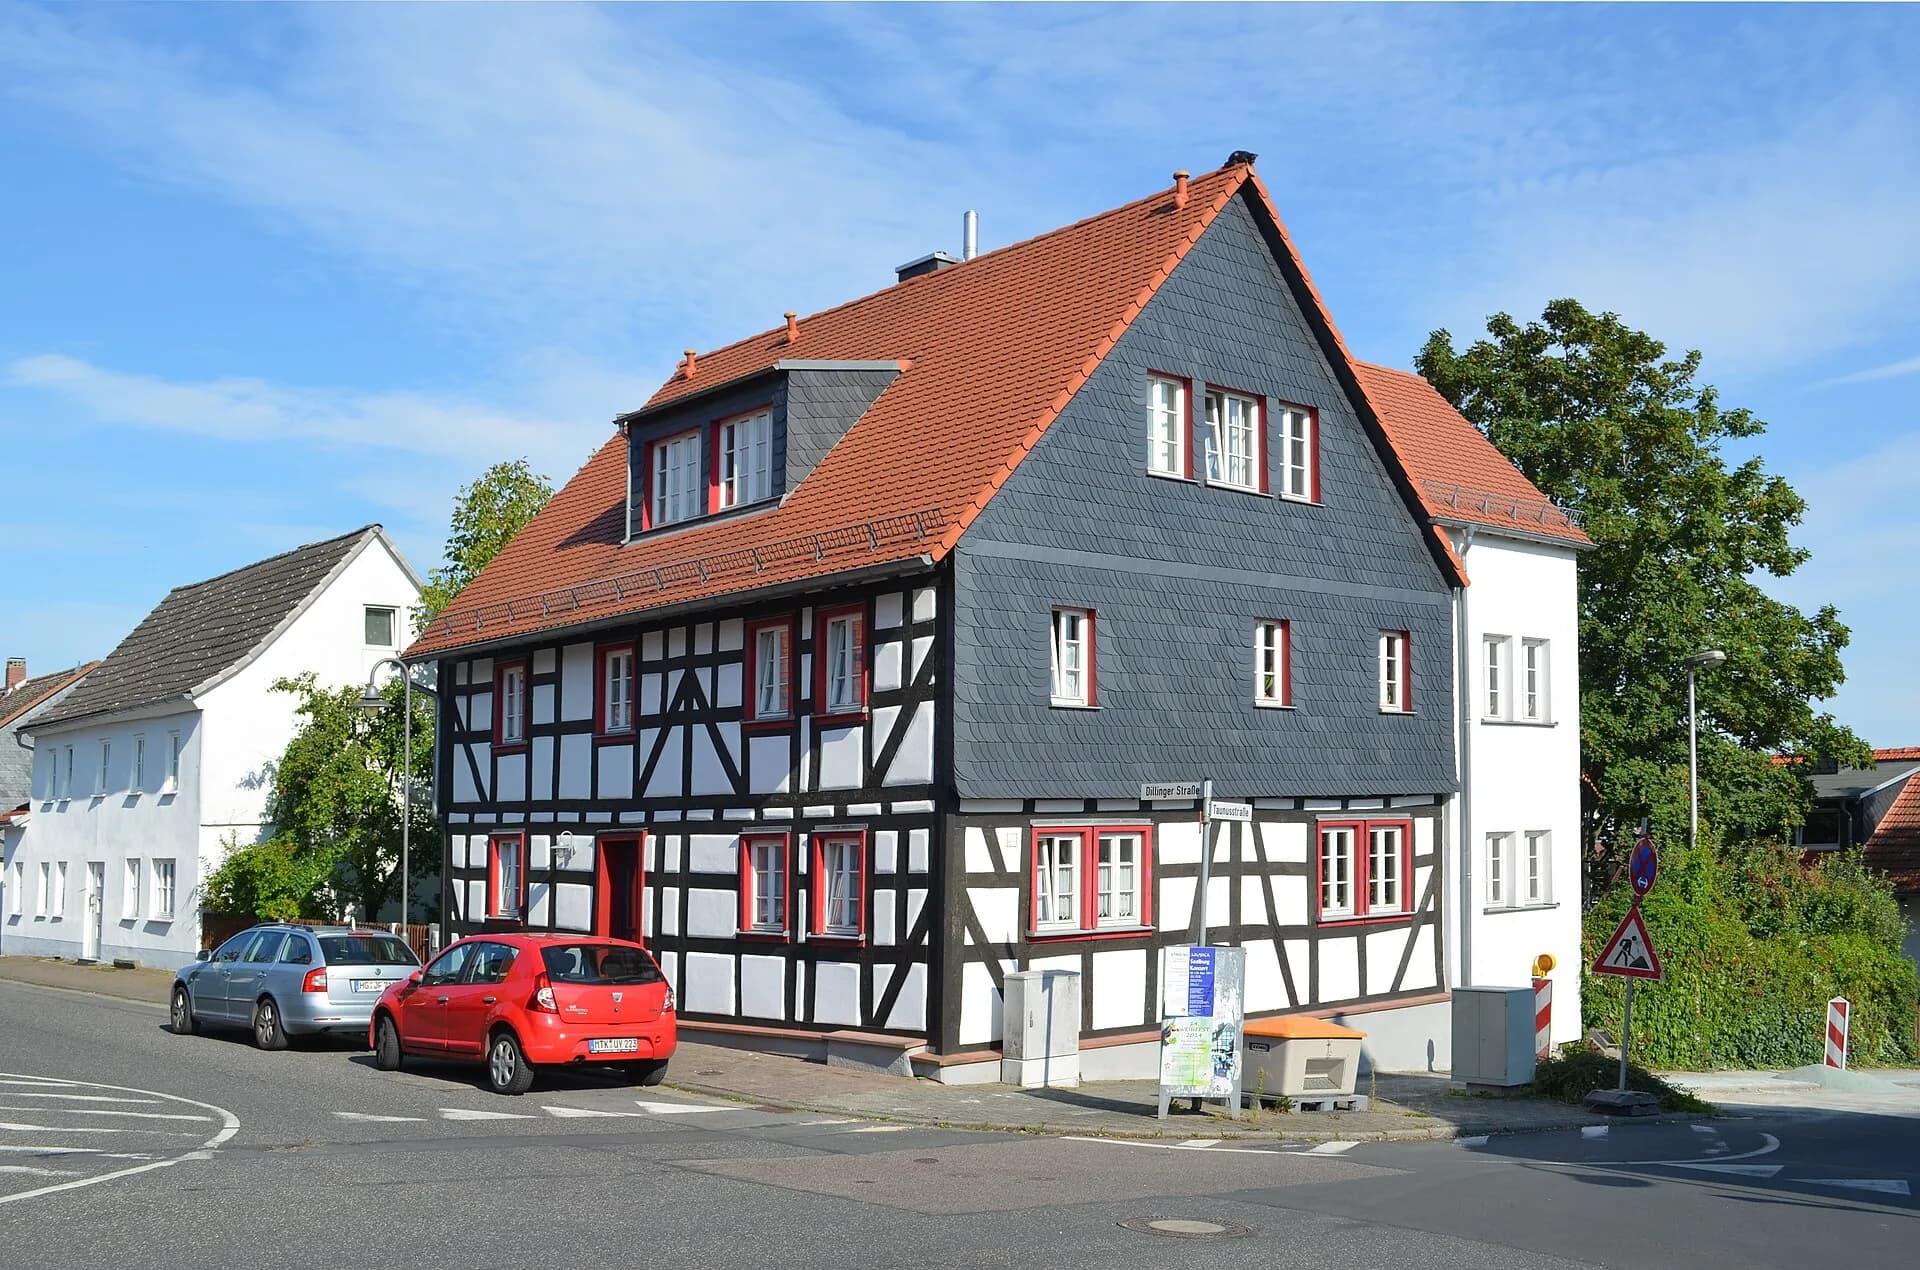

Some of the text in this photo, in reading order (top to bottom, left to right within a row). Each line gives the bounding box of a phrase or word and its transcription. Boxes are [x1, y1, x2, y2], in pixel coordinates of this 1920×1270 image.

[1145, 785, 1200, 798] Dillinger Straße
[1213, 804, 1249, 817] Taunusstraße
[625, 1040, 636, 1048] 223
